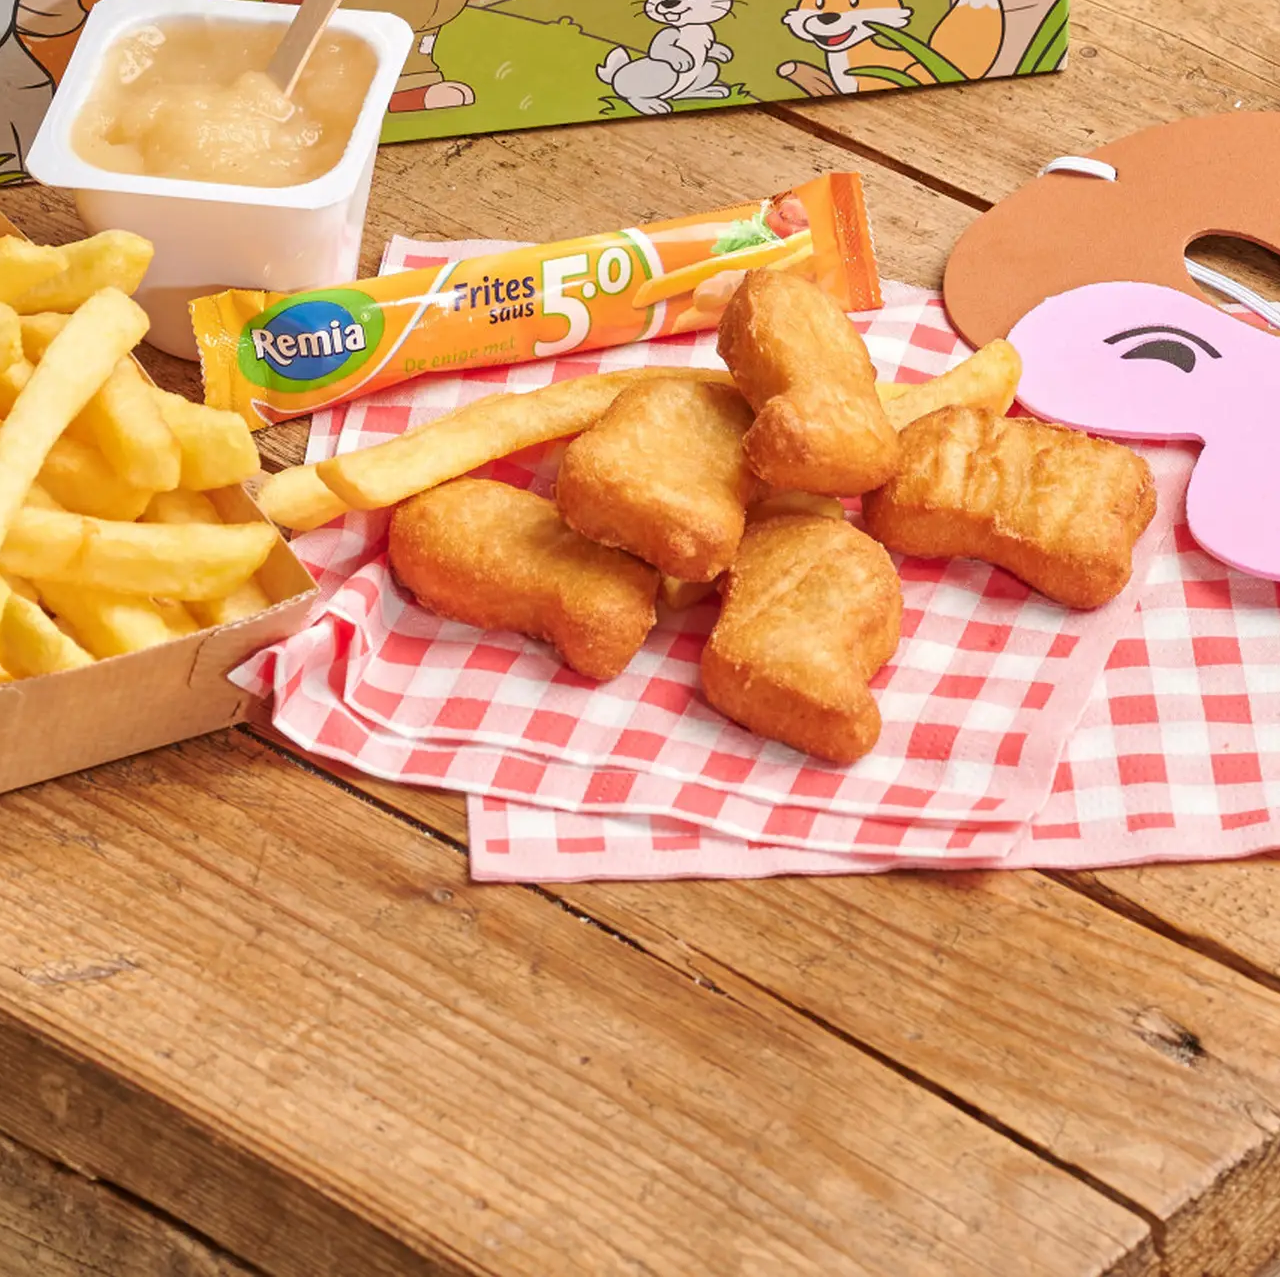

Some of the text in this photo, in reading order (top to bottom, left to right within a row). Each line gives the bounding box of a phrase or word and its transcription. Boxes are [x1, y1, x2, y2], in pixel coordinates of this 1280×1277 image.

[453, 275, 536, 311] Frites
[489, 302, 535, 324] saus
[250, 319, 366, 366] Remia
